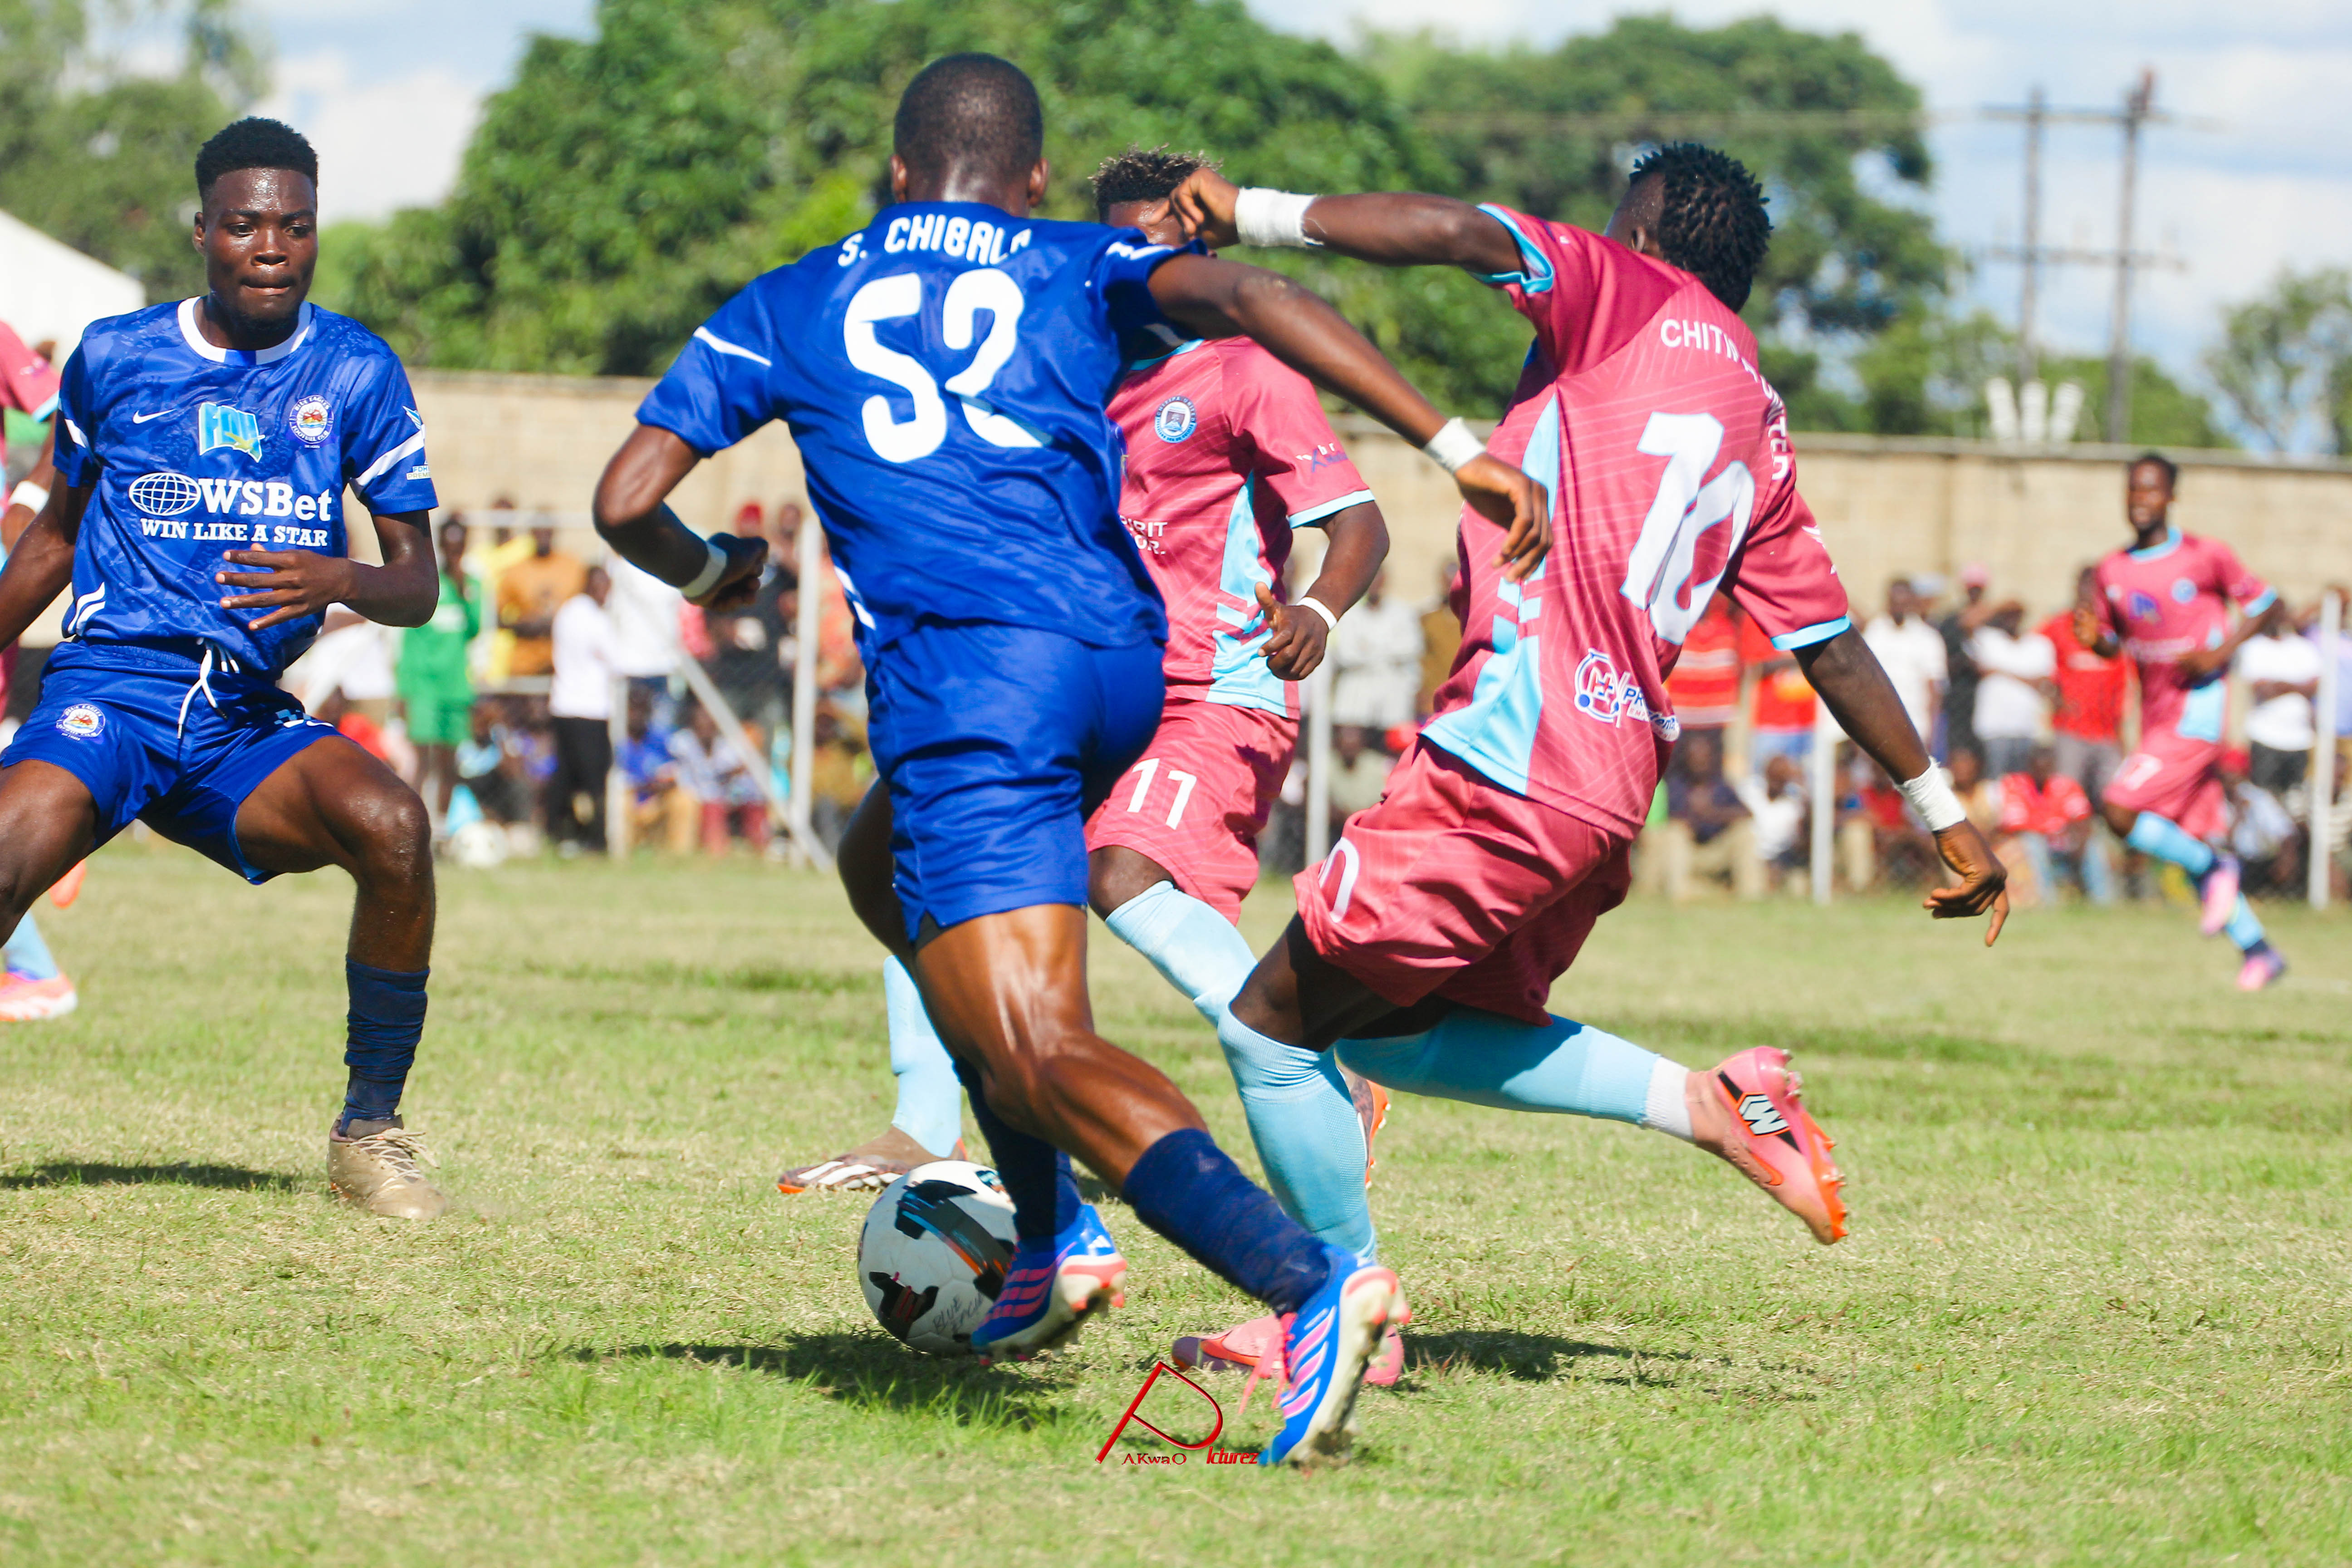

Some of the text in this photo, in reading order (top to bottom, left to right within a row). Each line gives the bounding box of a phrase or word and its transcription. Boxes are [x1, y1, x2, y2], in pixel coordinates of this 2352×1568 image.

[838, 232, 868, 267] S.
[843, 268, 1054, 464] 52
[198, 478, 332, 522] WSBet
[140, 518, 328, 547] WIN LIKE A STAR
